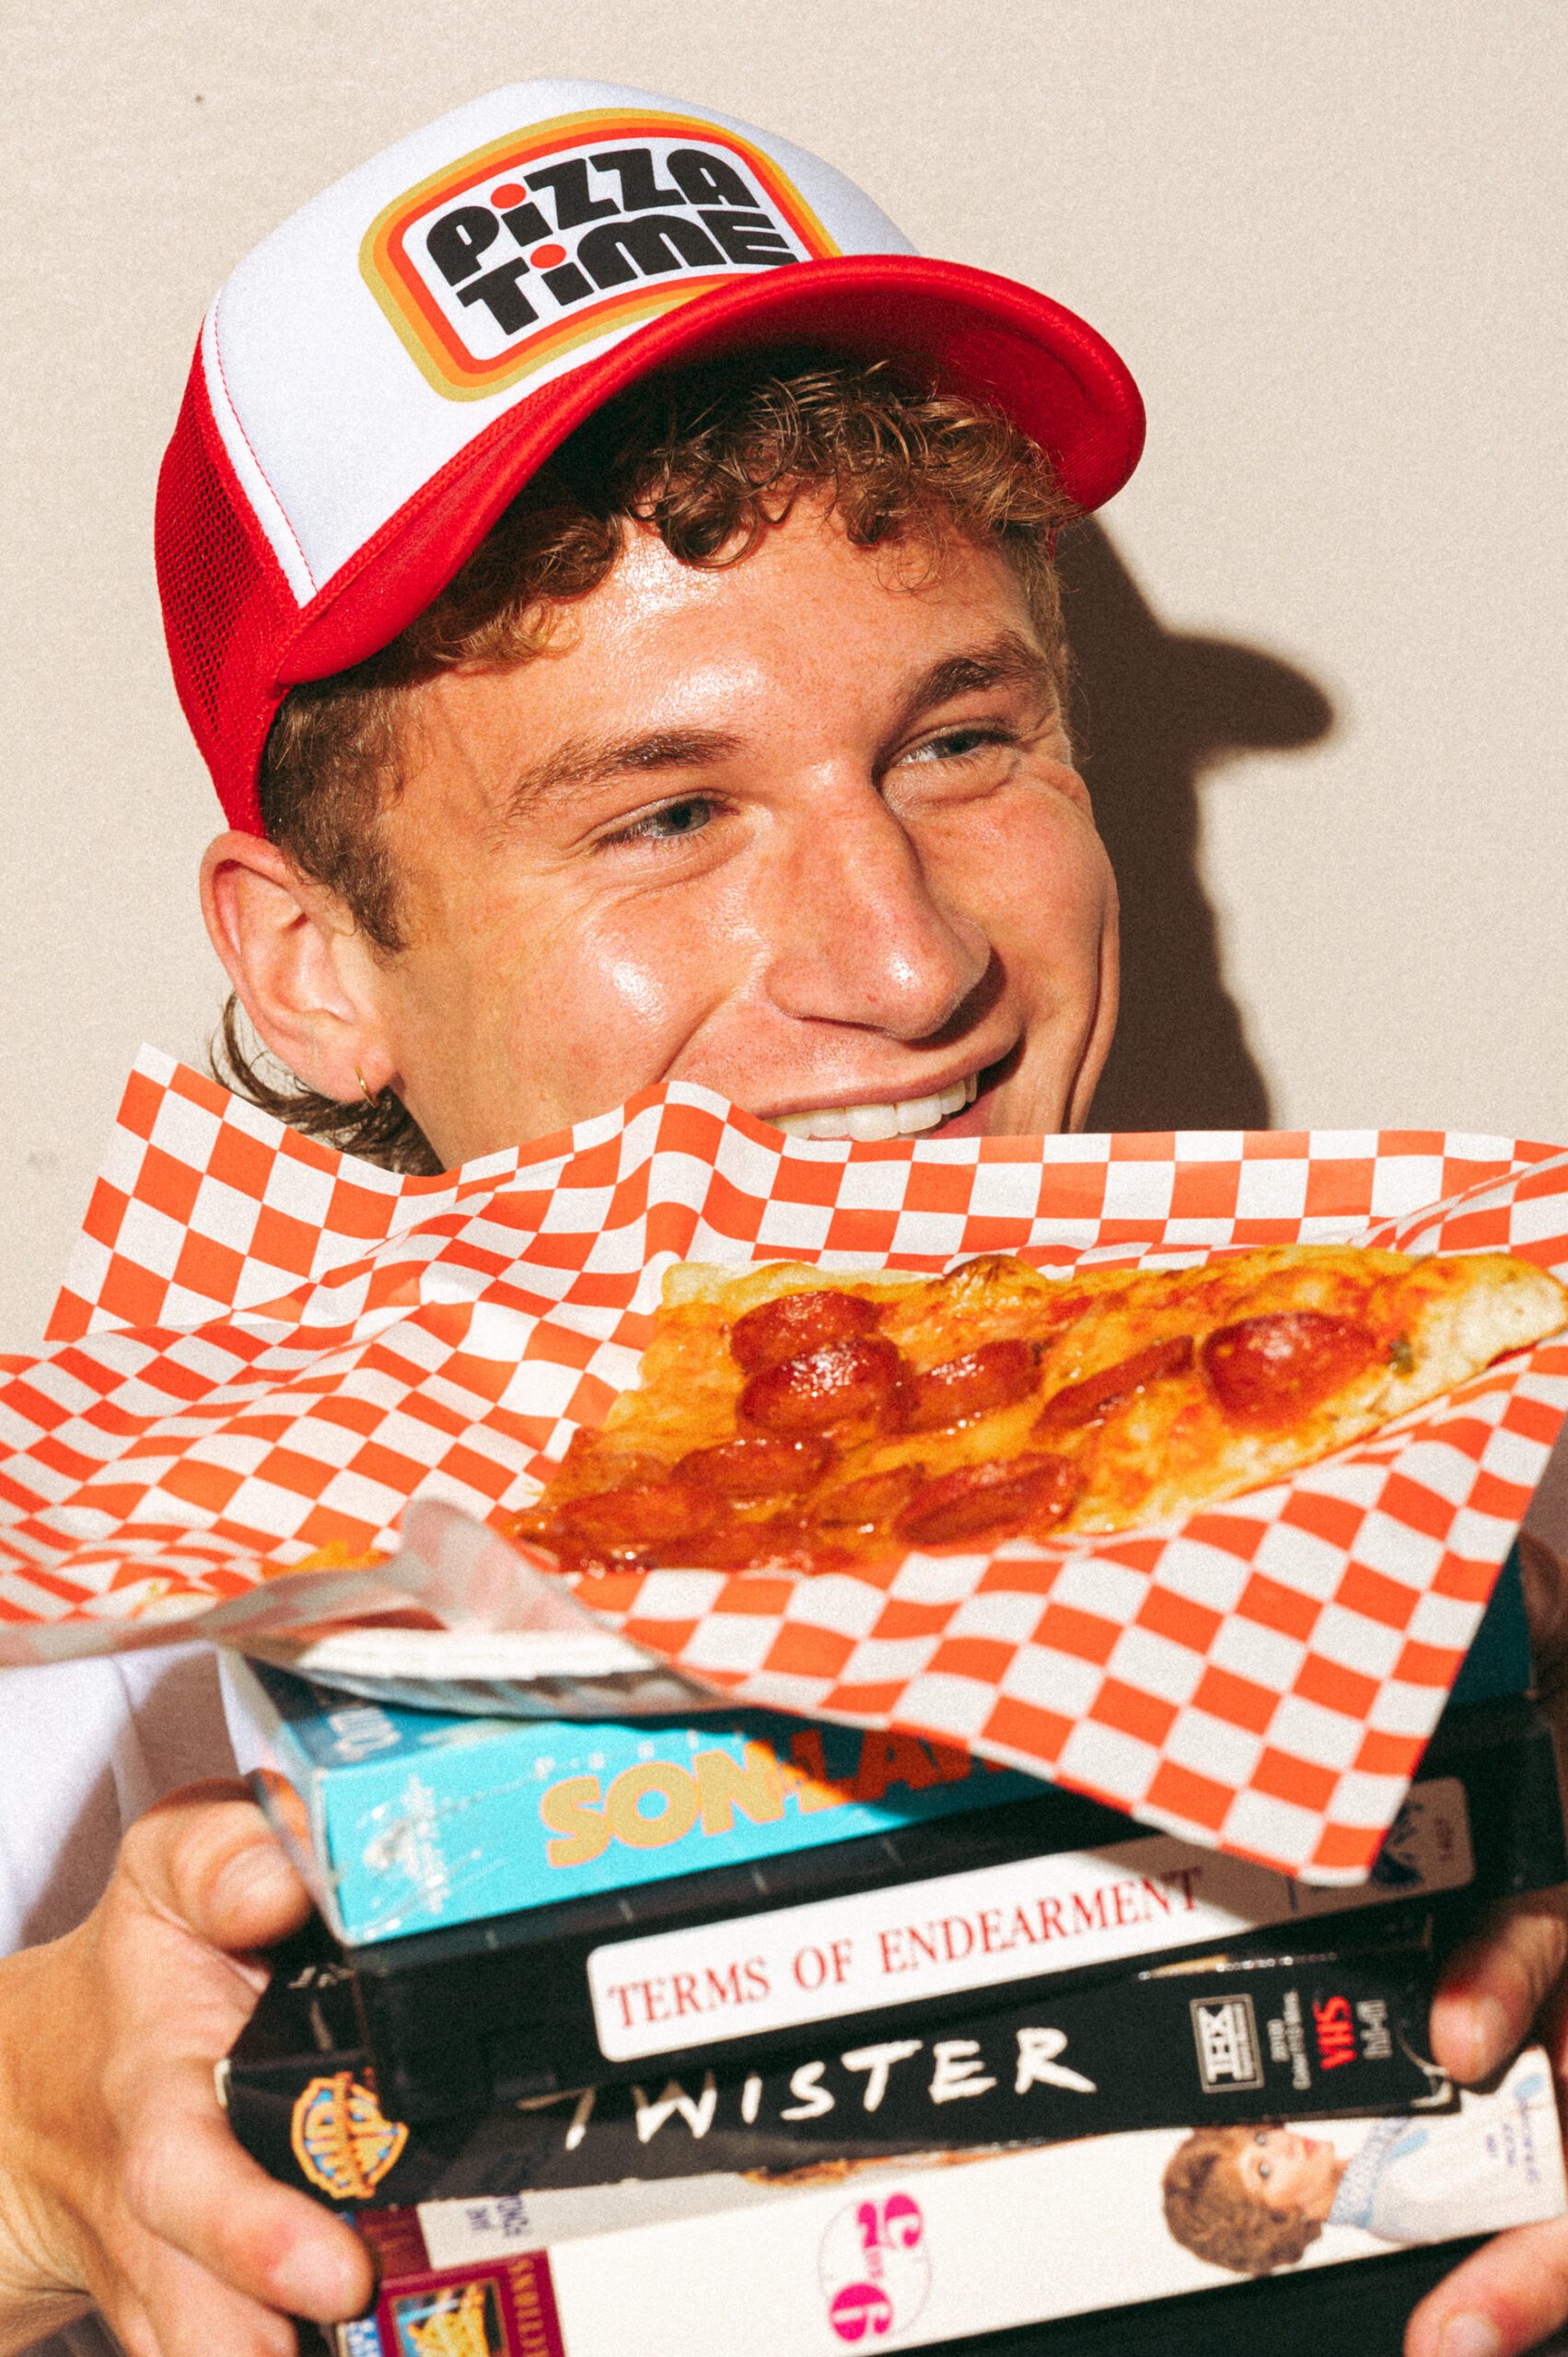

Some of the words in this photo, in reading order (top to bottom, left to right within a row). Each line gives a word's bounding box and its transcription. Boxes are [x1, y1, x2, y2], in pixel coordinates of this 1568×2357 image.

[539, 1740, 785, 1869] SON
[607, 1957, 771, 2029] TERMS
[792, 1940, 854, 1991] OF
[880, 1865, 1204, 1976] ENDEARMENT
[516, 2026, 1097, 2151] TWISTER
[1312, 1994, 1356, 2071] VHS
